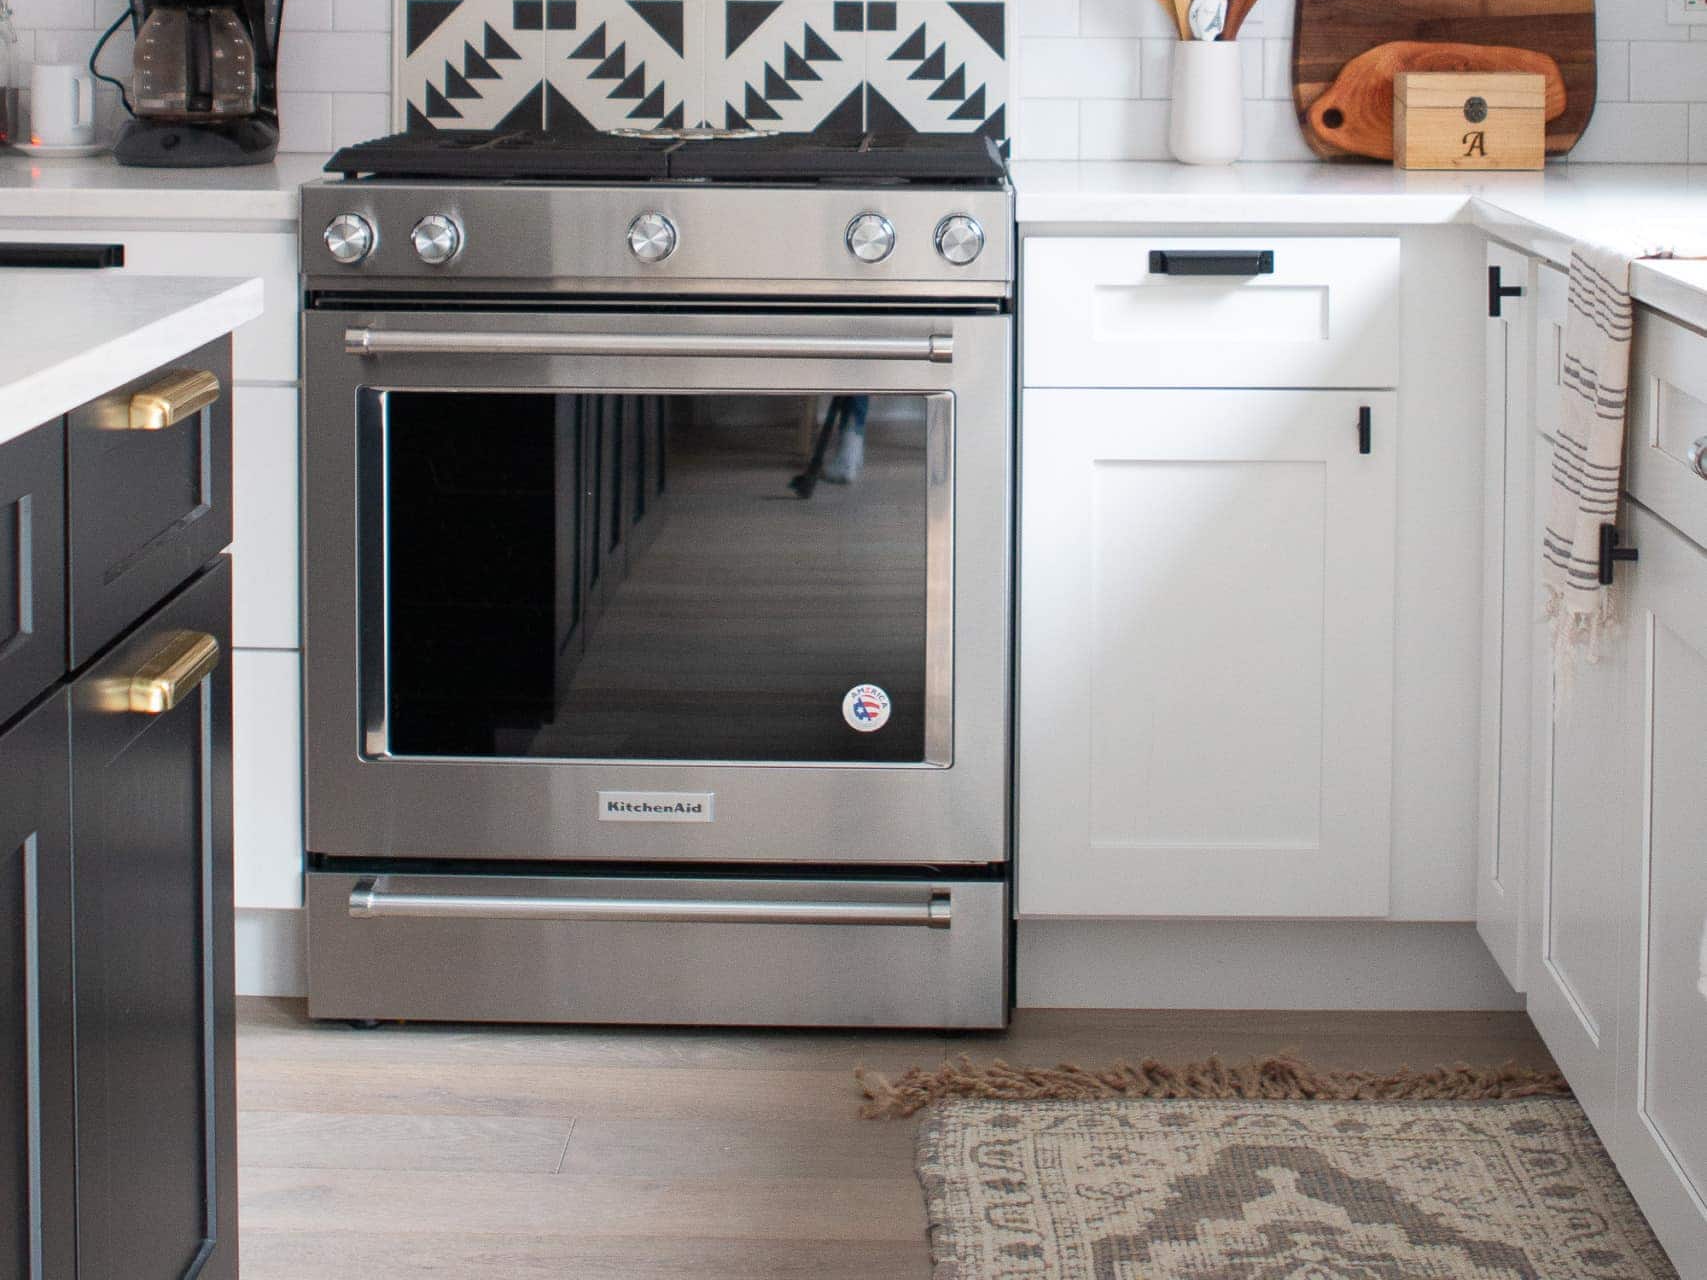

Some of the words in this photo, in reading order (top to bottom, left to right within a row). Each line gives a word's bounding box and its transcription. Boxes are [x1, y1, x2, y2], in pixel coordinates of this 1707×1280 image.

[1462, 131, 1488, 157] A
[851, 686, 888, 709] AMERICA
[607, 801, 702, 813] KitchenAid
